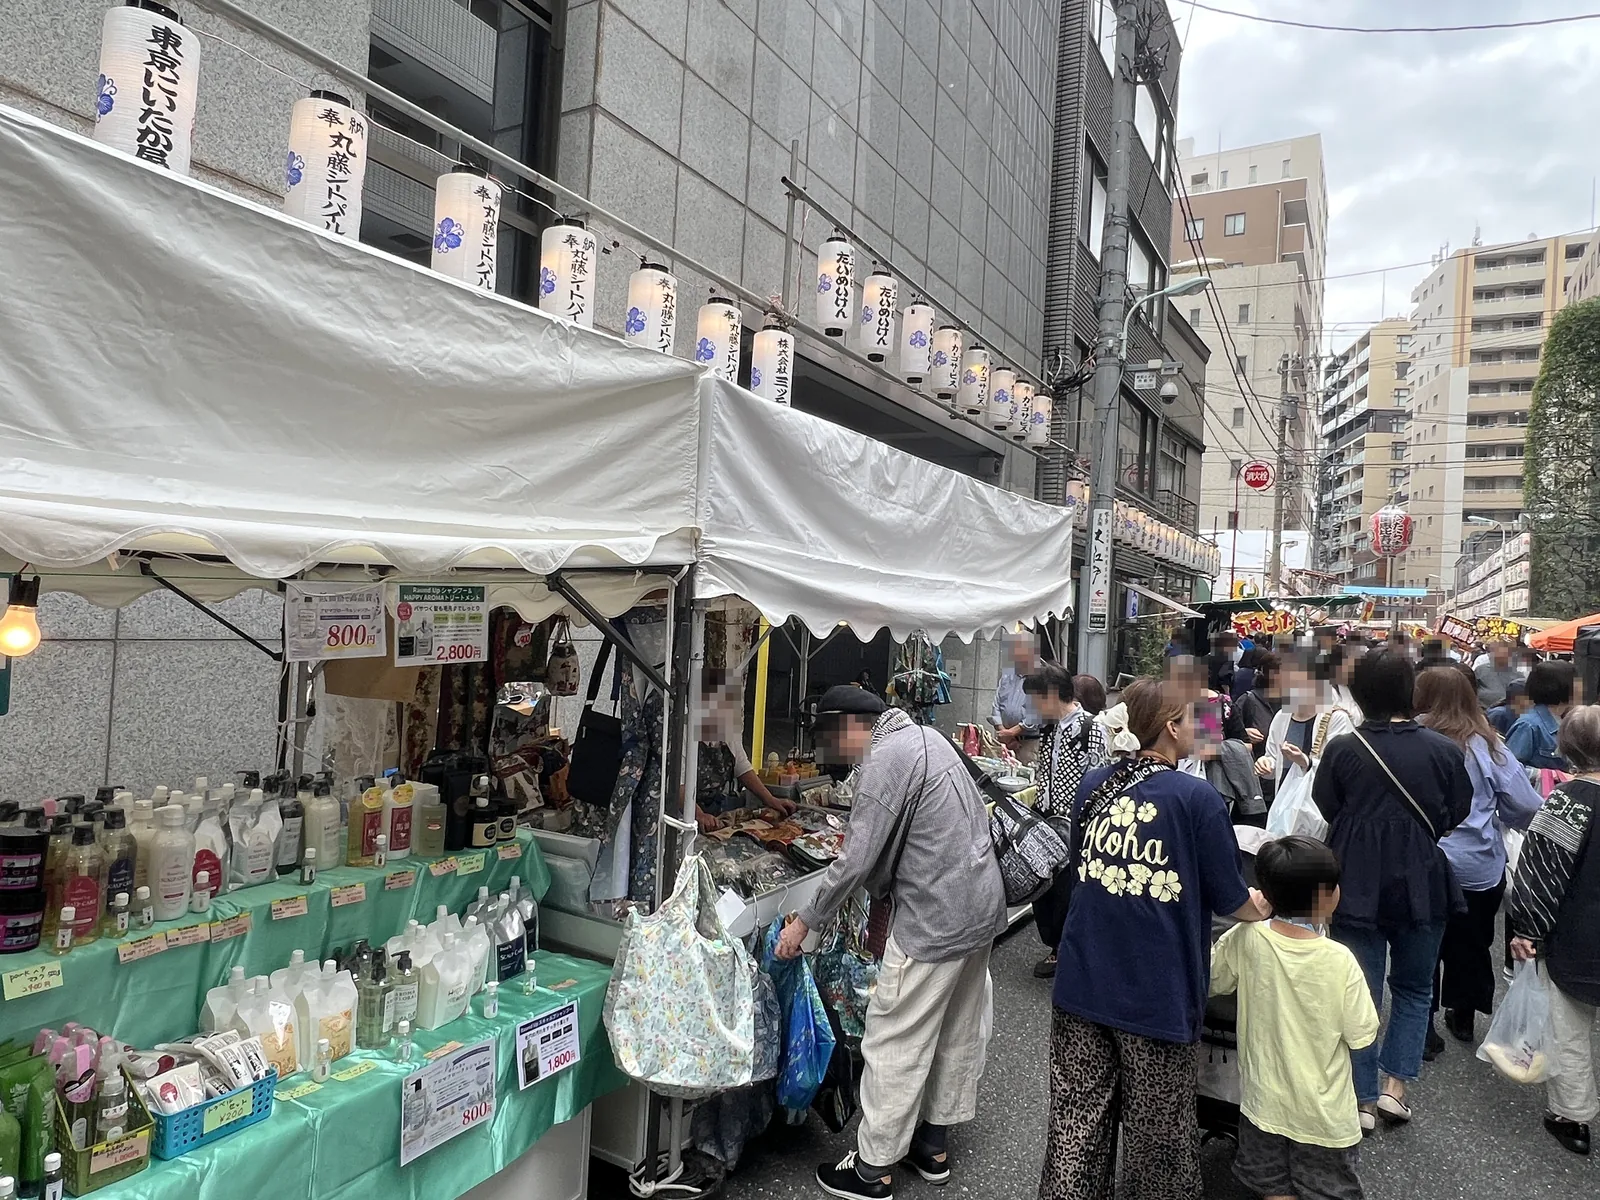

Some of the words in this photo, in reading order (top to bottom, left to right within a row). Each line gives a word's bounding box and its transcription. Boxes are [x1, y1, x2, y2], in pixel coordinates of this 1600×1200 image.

[835, 251, 850, 319] たいめいけん
[876, 285, 893, 346] たいめいけん
[1246, 470, 1269, 482] 消火栓
[327, 623, 376, 647] 800円
[436, 643, 482, 663] 2,800円
[1080, 815, 1169, 866] Aloha
[548, 1049, 576, 1073] 1,800円
[219, 1107, 244, 1125] ¥200
[462, 1101, 493, 1126] 800円
